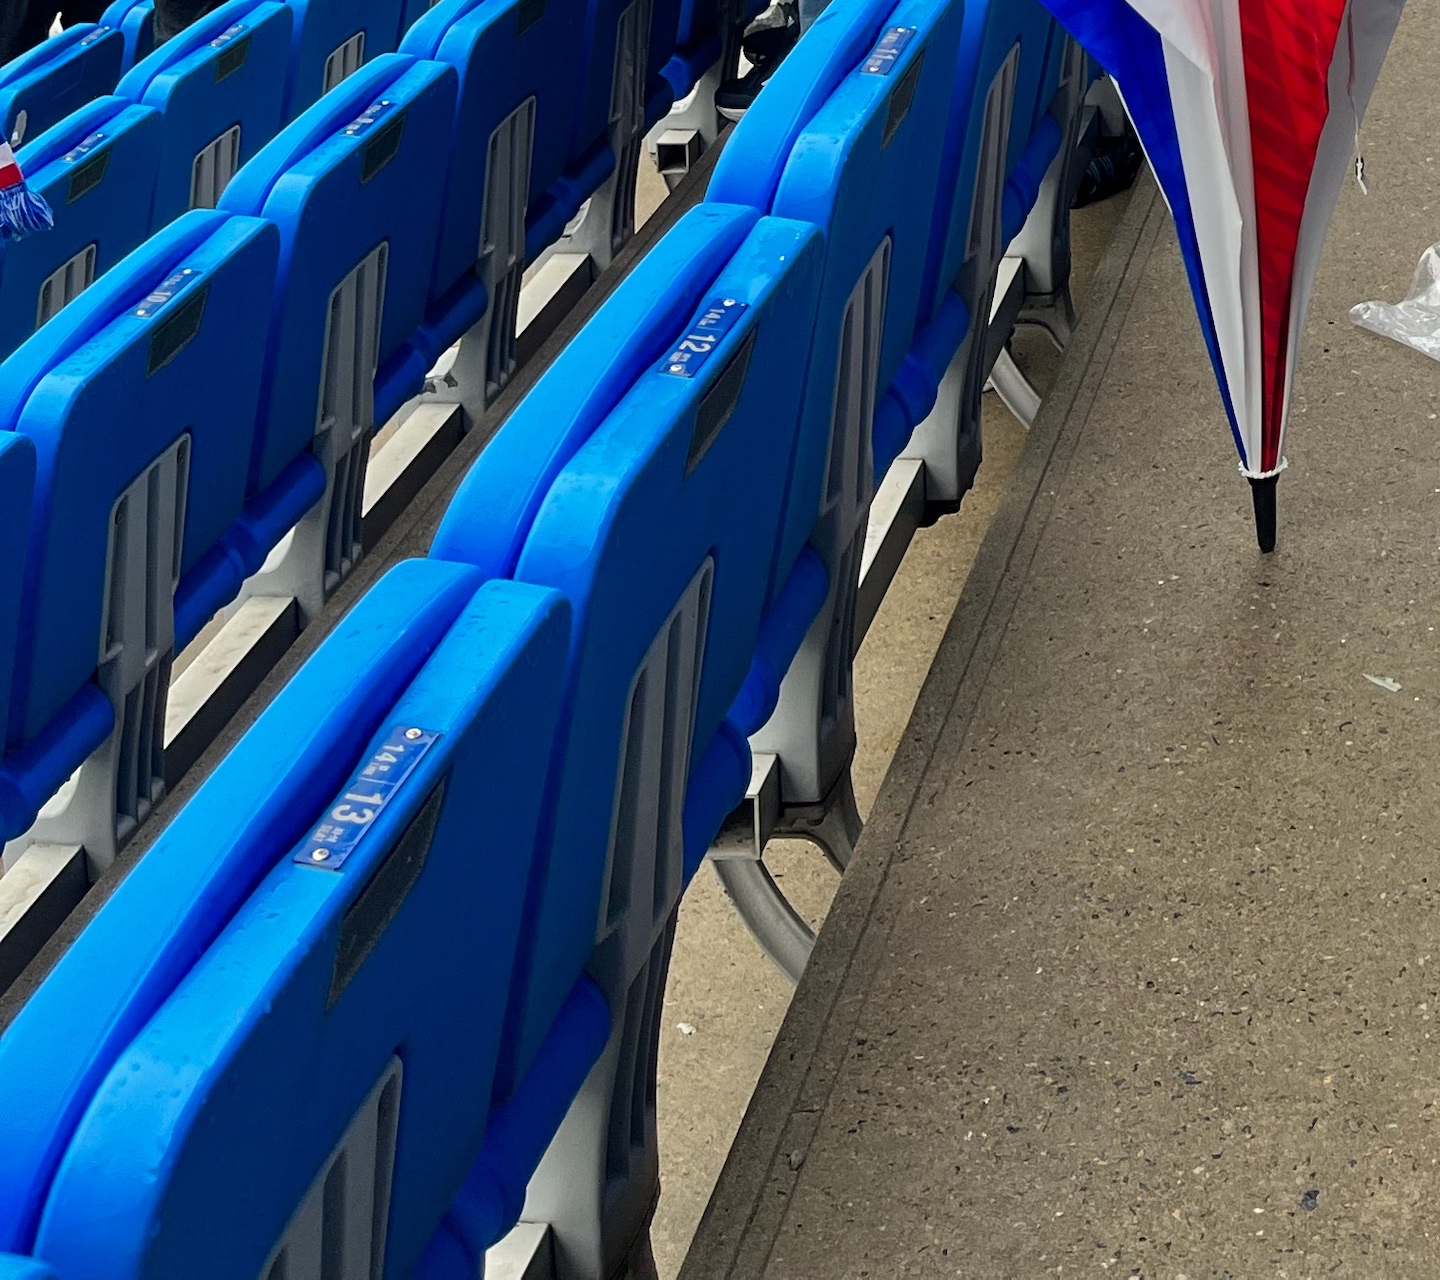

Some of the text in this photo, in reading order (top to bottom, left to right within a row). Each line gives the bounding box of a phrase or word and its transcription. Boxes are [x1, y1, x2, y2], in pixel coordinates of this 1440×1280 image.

[679, 335, 717, 352] 12
[375, 744, 405, 763] 14
[345, 793, 383, 824] 13
